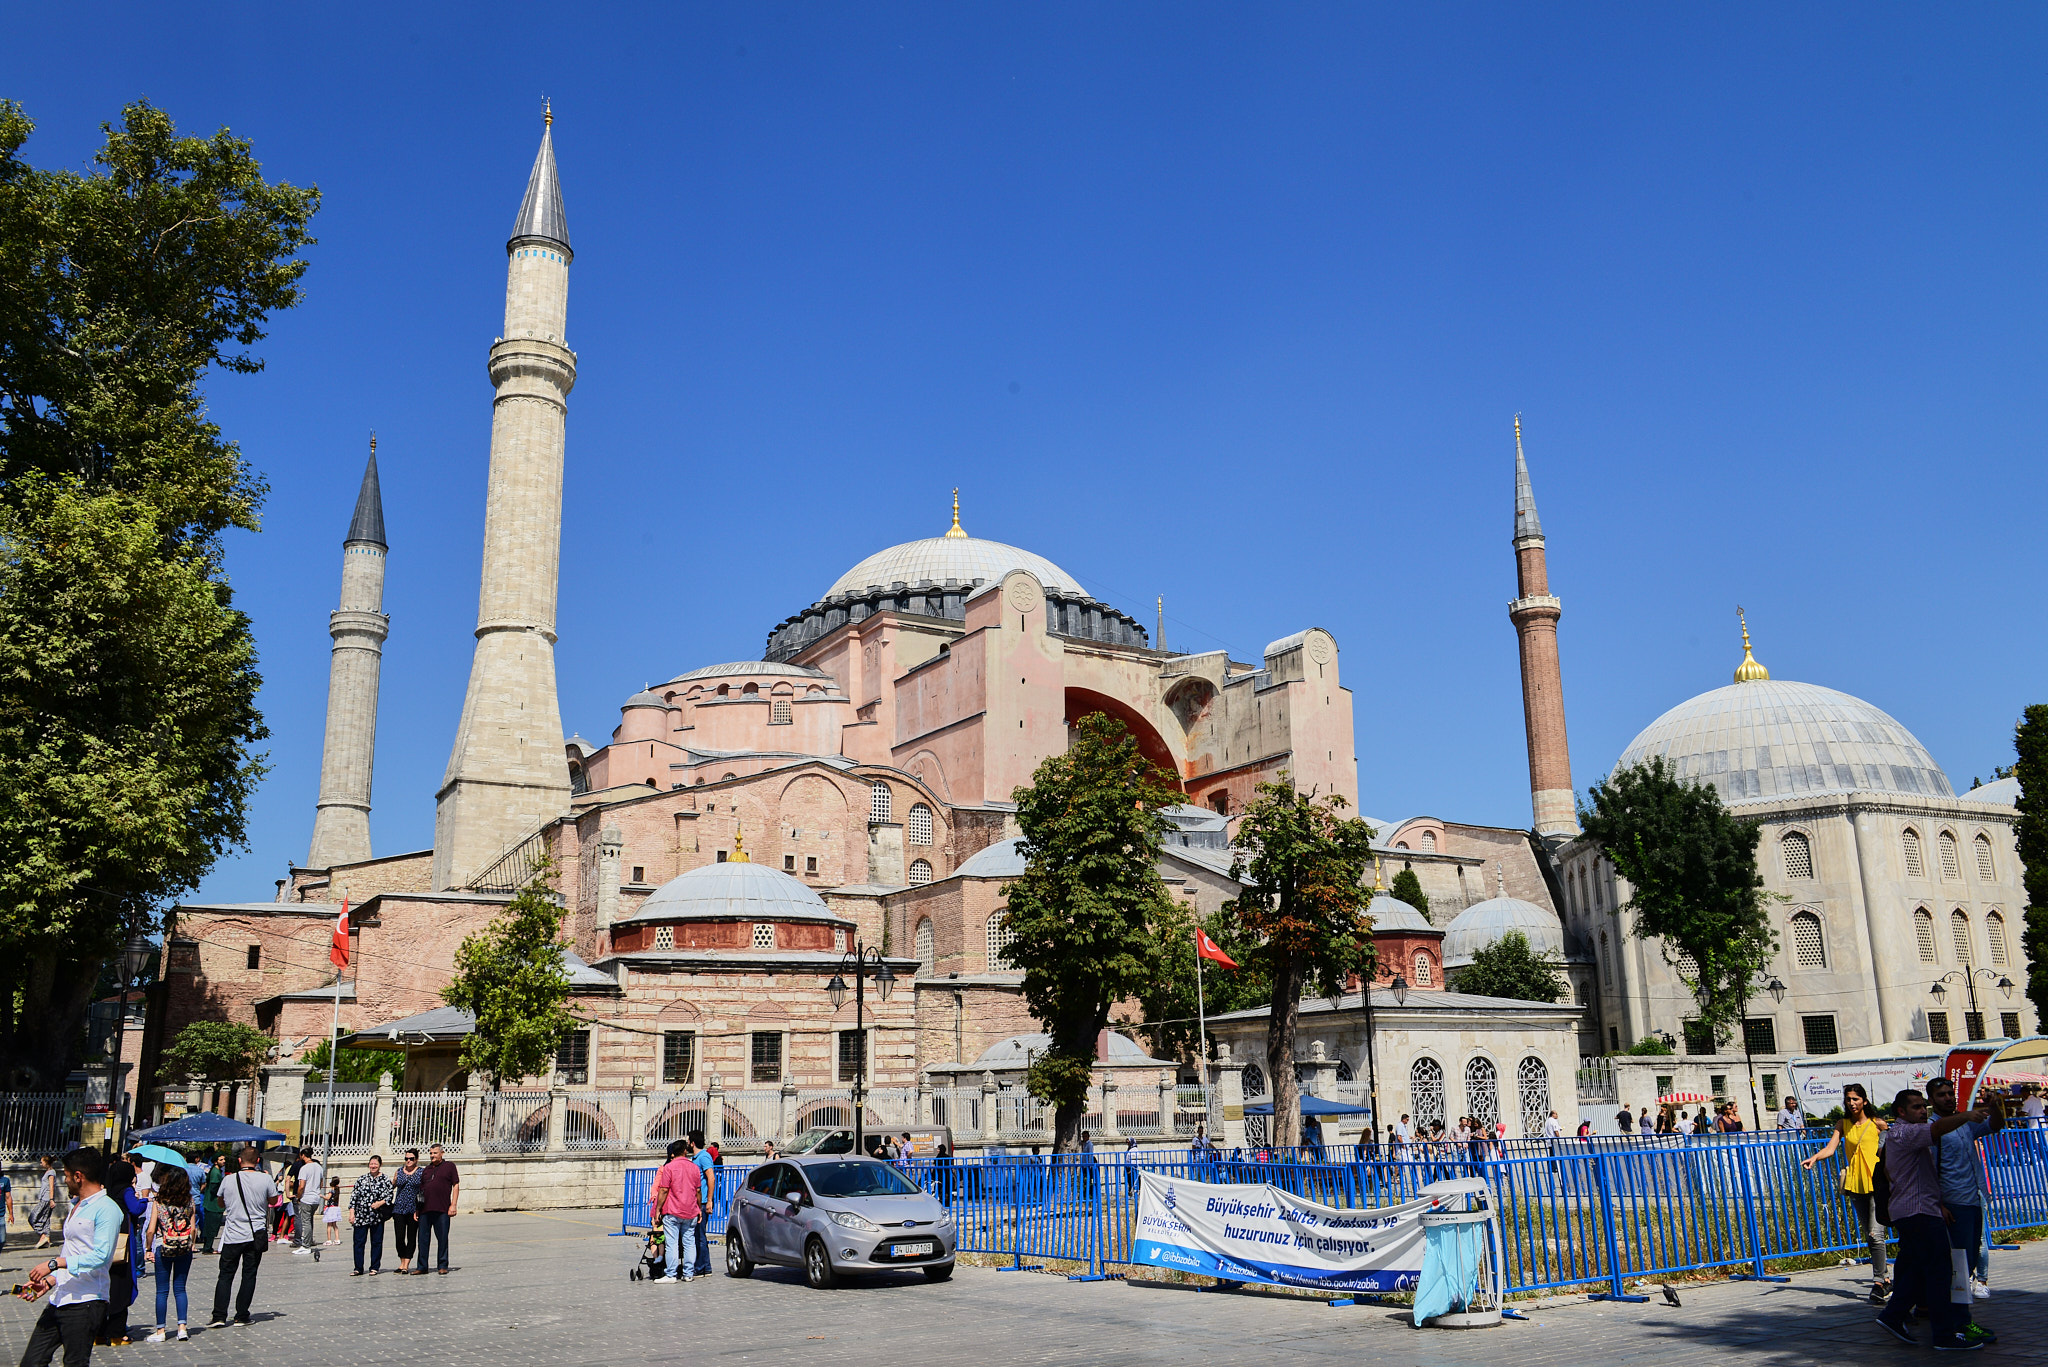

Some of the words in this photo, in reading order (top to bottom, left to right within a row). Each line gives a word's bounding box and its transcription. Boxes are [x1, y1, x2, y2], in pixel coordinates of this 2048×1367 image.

[1206, 1197, 1275, 1219] Büyükşehir
[1382, 1216, 1398, 1228] ve
[905, 1244, 913, 1253] UZ
[1224, 1223, 1290, 1246] huzurunuz
[1293, 1231, 1313, 1251] için
[1316, 1235, 1376, 1256] çalışıyor.
